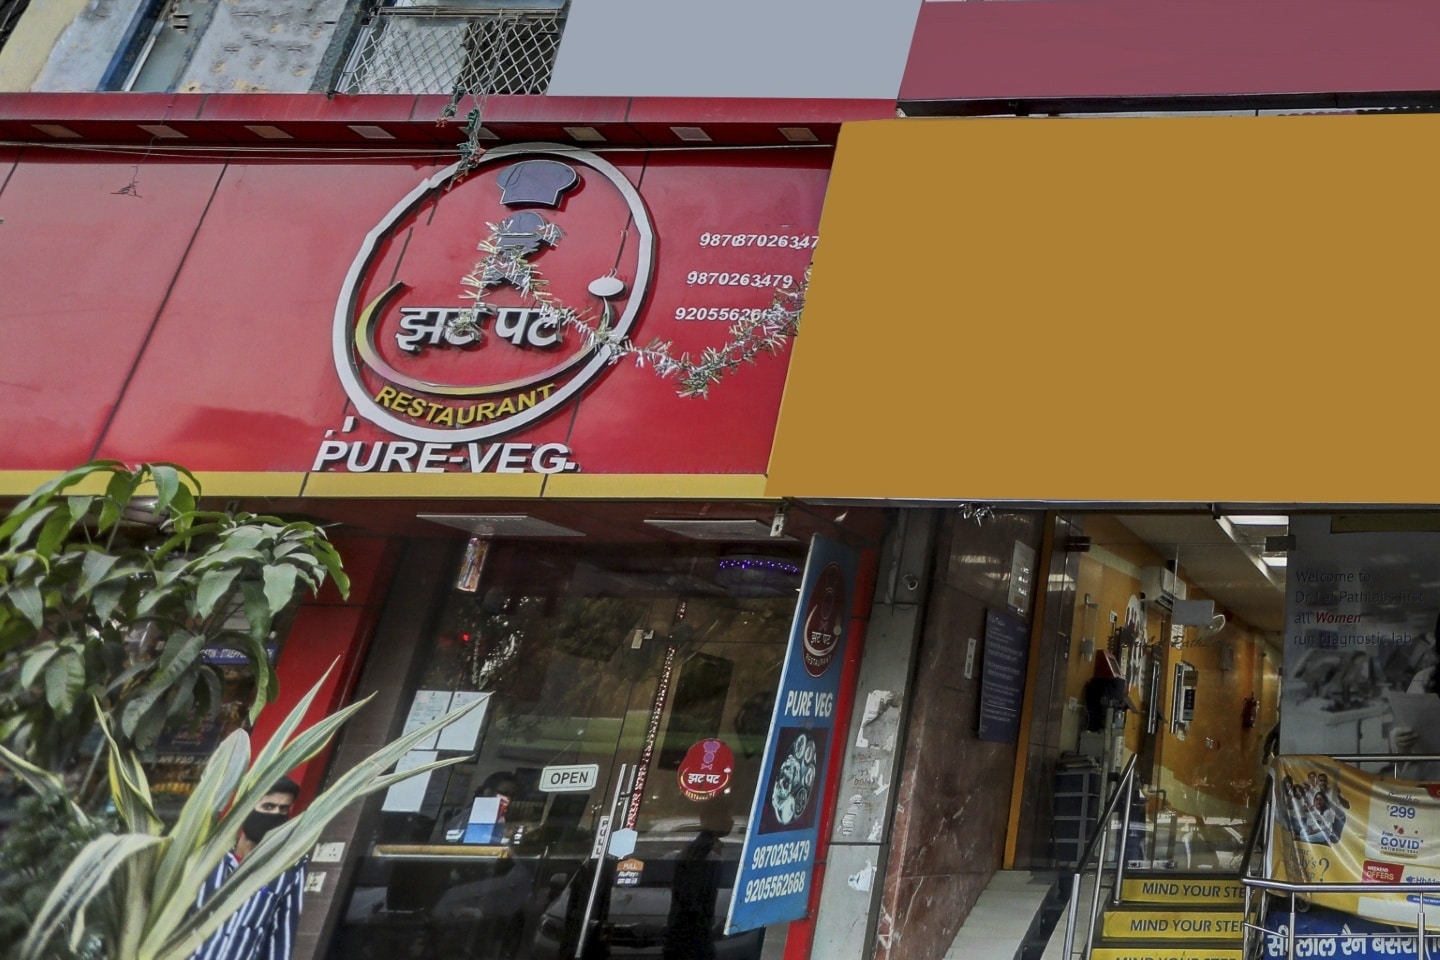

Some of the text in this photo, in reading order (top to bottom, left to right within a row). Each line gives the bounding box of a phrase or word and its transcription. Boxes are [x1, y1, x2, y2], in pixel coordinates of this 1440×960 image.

[686, 271, 793, 288] 9870263479
[374, 384, 556, 426] RESTAURANT
[1295, 571, 1371, 583] Welcome to
[1294, 611, 1362, 624] all Women
[784, 690, 834, 718] PURE VEG
[550, 772, 589, 784] OPEN
[751, 839, 811, 870] 9870263479
[1367, 871, 1394, 881] OFFERS
[744, 871, 806, 904] 9205562668
[1142, 882, 1247, 898] MIND YOUR STE
[1130, 919, 1168, 931] MIND
[1172, 919, 1211, 932] YOUR
